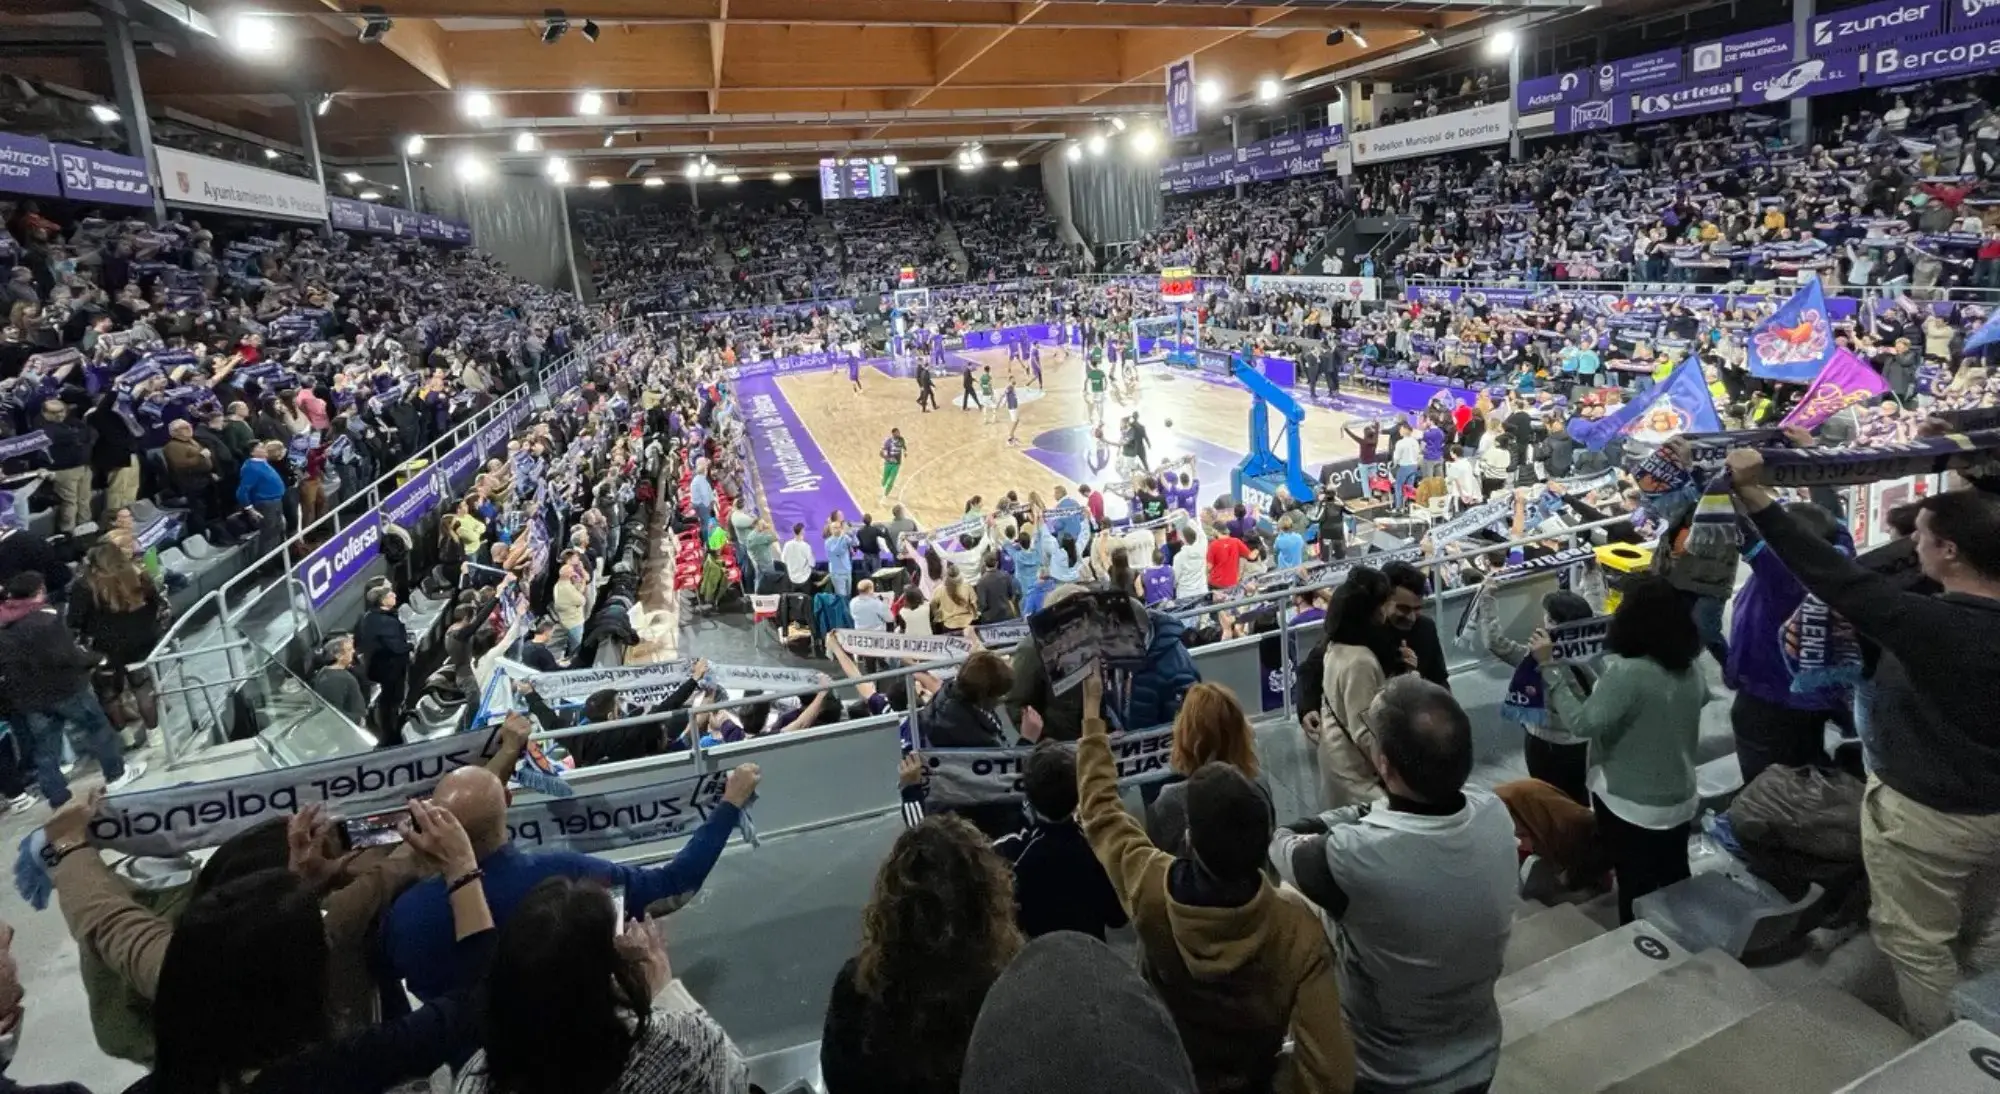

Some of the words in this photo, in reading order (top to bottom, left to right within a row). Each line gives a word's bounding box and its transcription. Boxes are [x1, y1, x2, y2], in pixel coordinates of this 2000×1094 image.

[1838, 5, 1931, 36] zunder
[1724, 53, 1738, 62] DE
[1739, 44, 1788, 60] PALENCIA
[1174, 82, 1188, 108] 10
[1672, 83, 1733, 101] ortega
[1405, 133, 1442, 146] Municipal
[1444, 130, 1455, 140] de
[1457, 123, 1500, 137] Deportes
[93, 177, 149, 194] BUJ
[203, 181, 274, 207] Ayuntamiento
[763, 427, 823, 493] Ayuntamiento
[1329, 460, 1396, 490] ends
[333, 524, 378, 572] cofersa
[1640, 940, 1662, 956] 5
